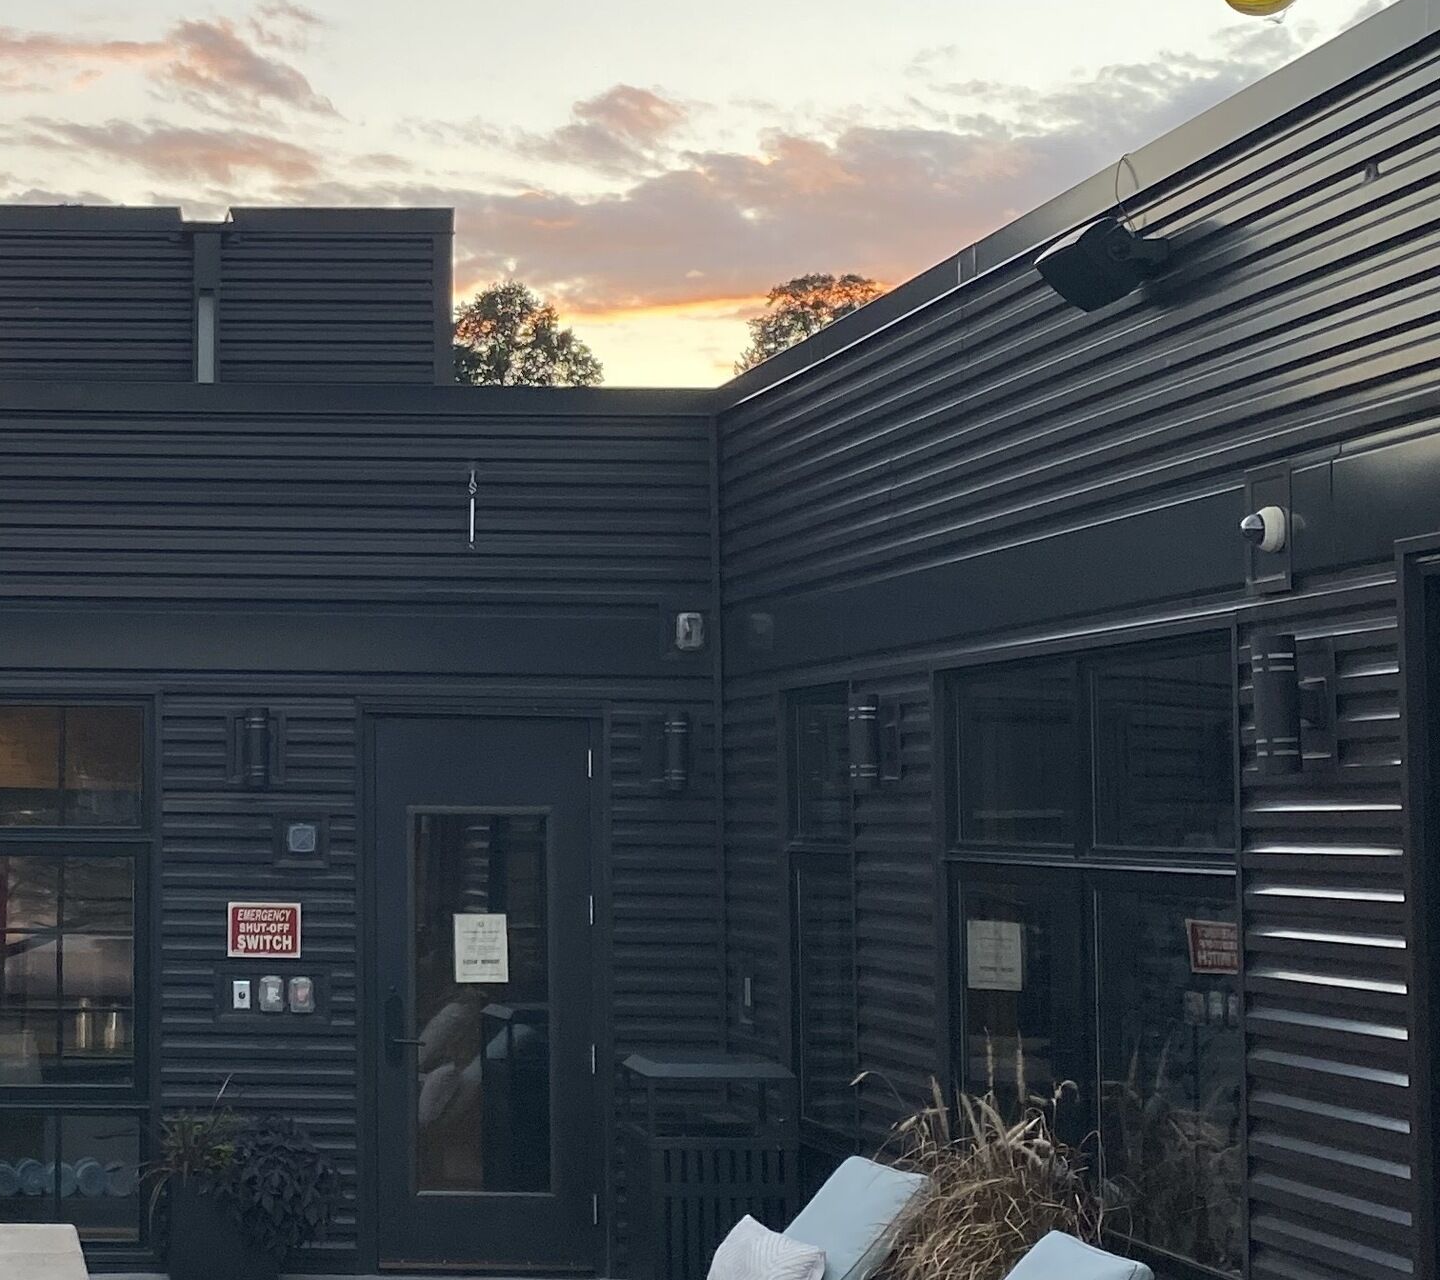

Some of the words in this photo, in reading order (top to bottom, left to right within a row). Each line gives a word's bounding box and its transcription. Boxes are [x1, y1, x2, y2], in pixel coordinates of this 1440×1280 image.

[237, 909, 292, 922] EMERGENCY
[239, 922, 290, 933] SHUT-OFF
[237, 934, 293, 951] SWITCH
